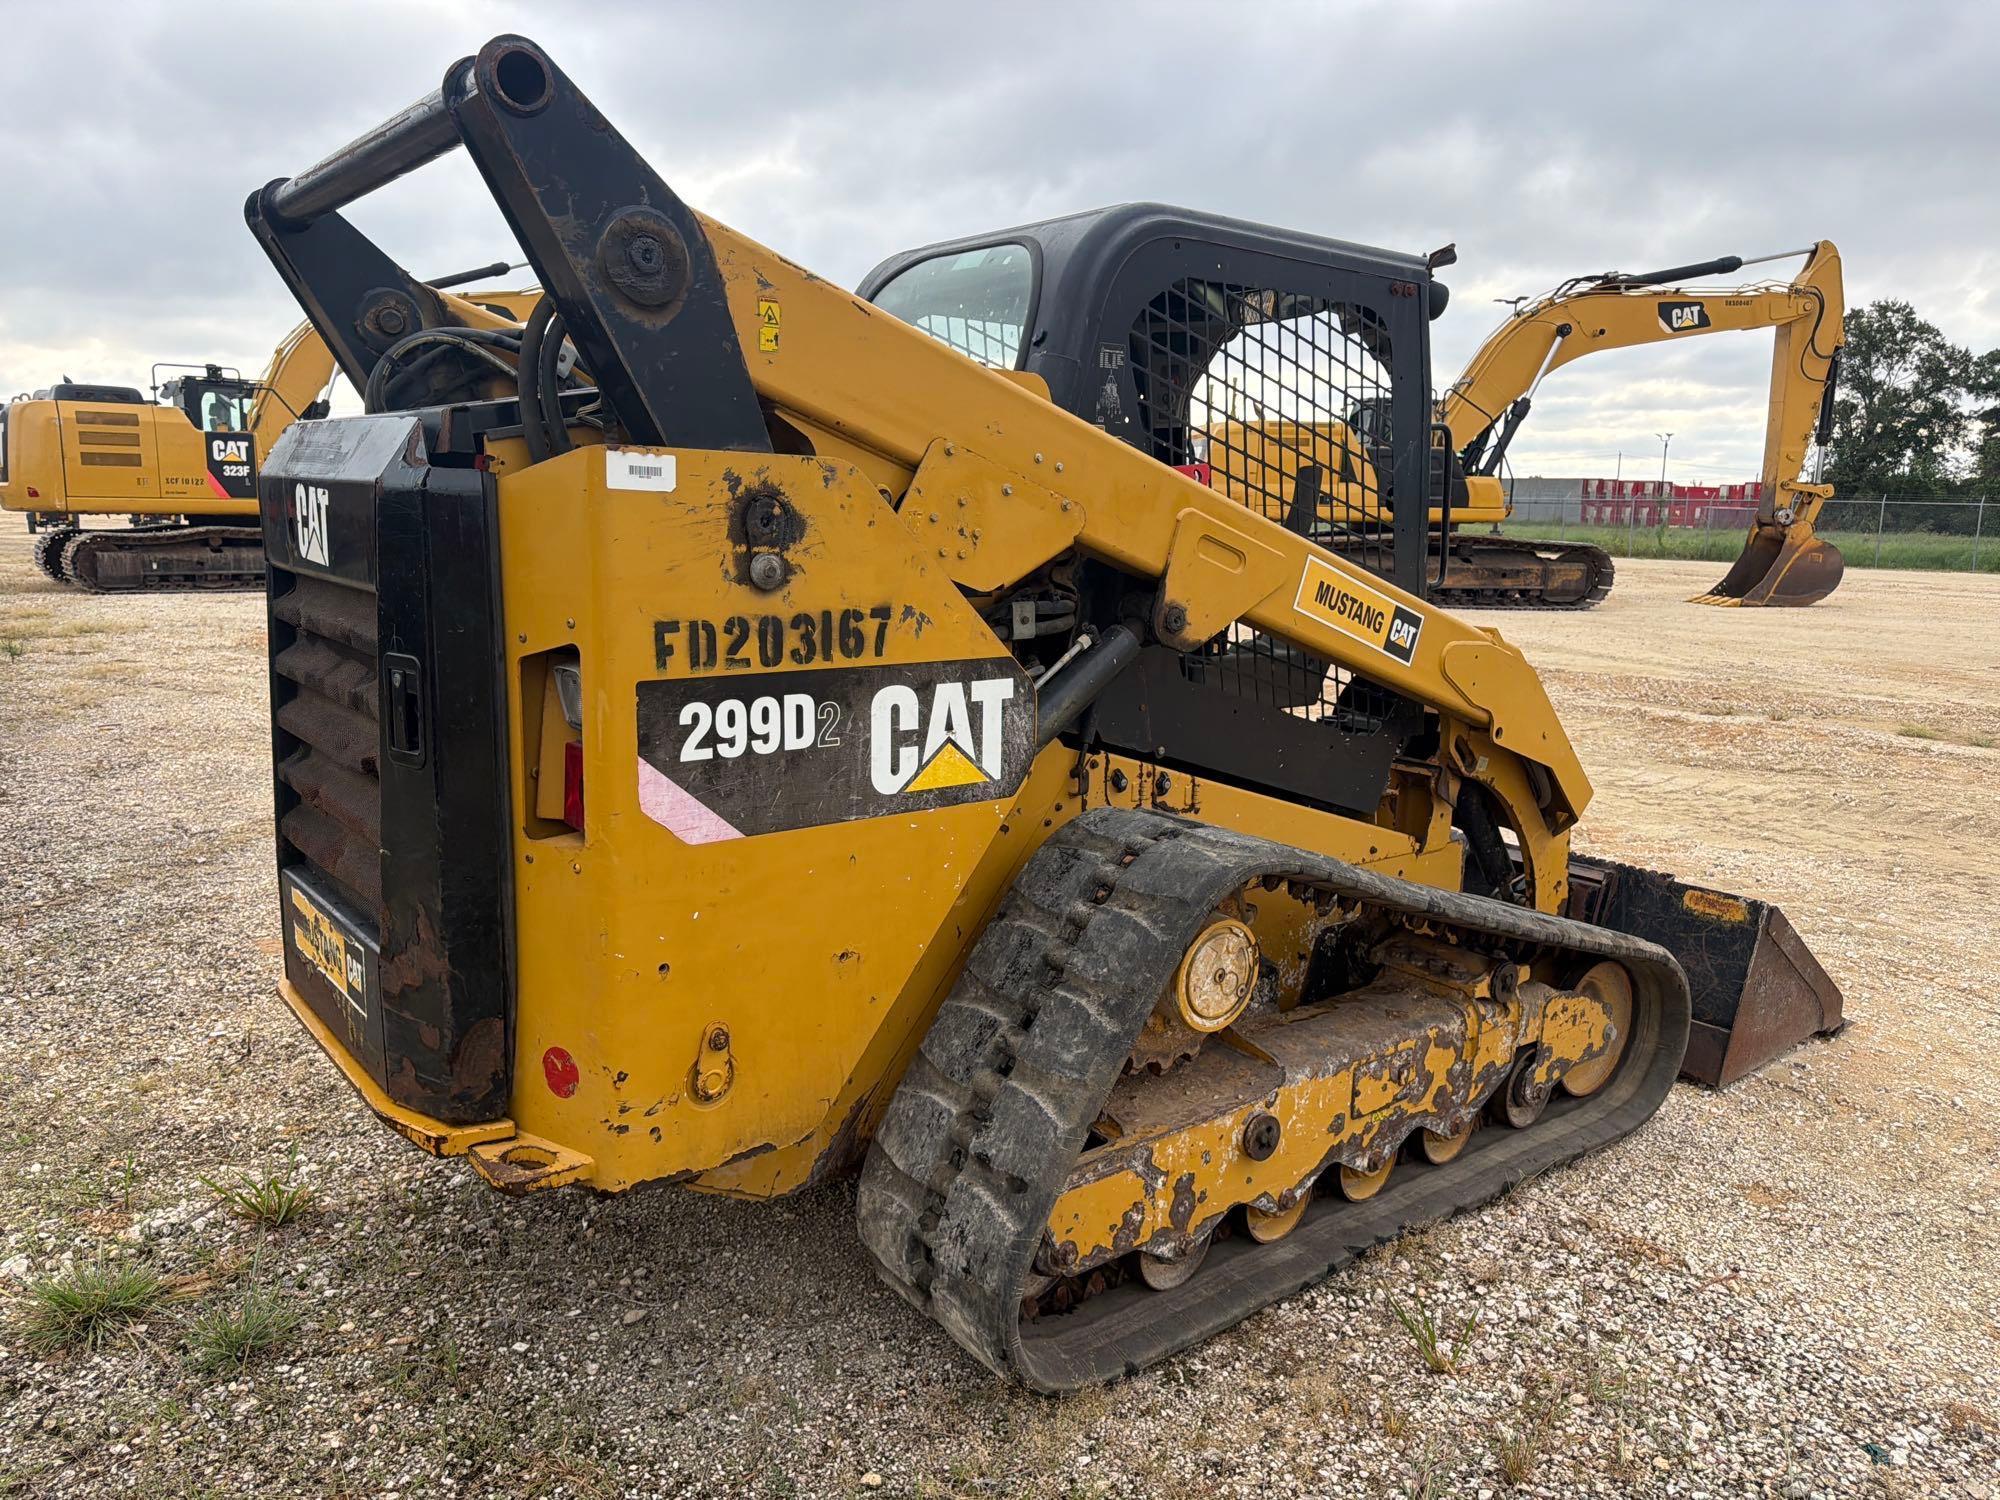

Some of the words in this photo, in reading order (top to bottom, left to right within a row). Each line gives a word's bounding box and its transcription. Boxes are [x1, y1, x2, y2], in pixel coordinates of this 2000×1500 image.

[1672, 305, 1701, 327] CAT
[212, 439, 249, 462] CAT
[223, 465, 251, 477] 323F
[295, 482, 330, 567] CAT
[653, 606, 893, 673] FD203167
[1314, 580, 1385, 634] MUSTANG
[1389, 618, 1417, 649] CAT
[870, 677, 1015, 796] CAT
[346, 953, 362, 993] CAT
